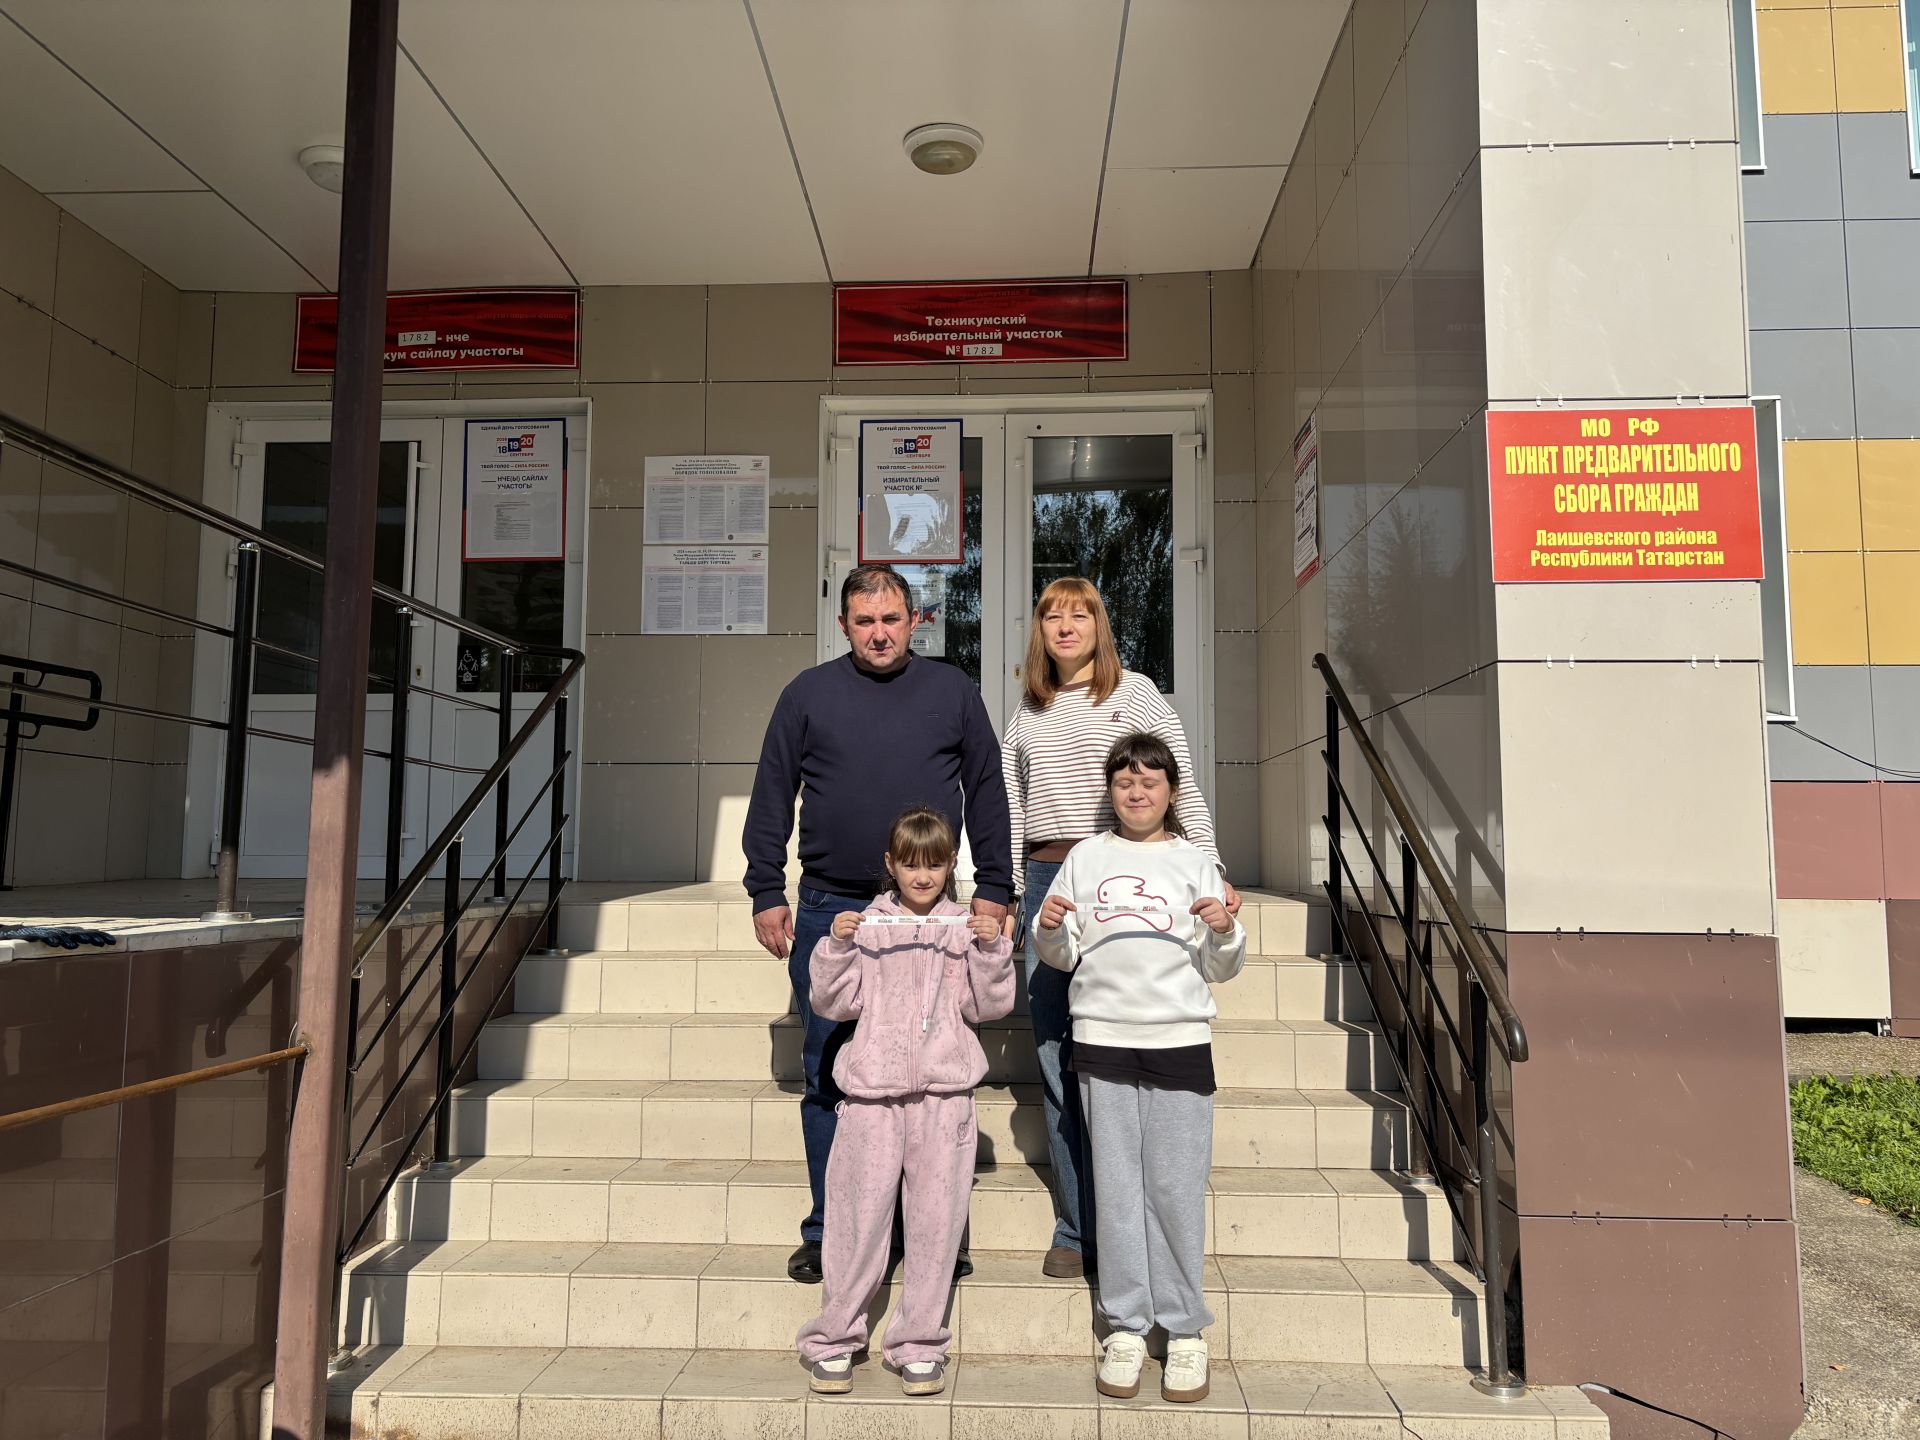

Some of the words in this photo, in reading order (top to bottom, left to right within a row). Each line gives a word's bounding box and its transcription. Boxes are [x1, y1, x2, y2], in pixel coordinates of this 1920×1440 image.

[925, 314, 1027, 328] Техникумский
[402, 333, 430, 342] 1782
[446, 333, 470, 342] нче
[893, 329, 1002, 343] избирательный
[1006, 330, 1063, 342] участок
[410, 348, 458, 360] сайлау
[460, 347, 524, 359] участогы
[945, 345, 961, 355] №
[966, 346, 995, 355] 1782
[1581, 417, 1611, 438] МО
[1628, 417, 1660, 437] РФ
[497, 446, 508, 454] 18
[509, 441, 519, 450] 19
[521, 437, 533, 446] 20
[894, 446, 904, 455] 18
[905, 442, 916, 450] 19
[917, 438, 930, 447] 20
[1505, 445, 1559, 475] ПУНКТ
[1562, 442, 1742, 478] ПРЕДВАРИТЕЛЬНОГО
[883, 475, 940, 483] ИЗБИРАТЕЛЬНЫЙ
[1553, 483, 1612, 514] СБОРА
[1614, 482, 1700, 517] ГРАЖДАН
[1535, 528, 1652, 547] Лаишевского
[1654, 527, 1718, 547] района
[1530, 549, 1633, 568] Республики
[1636, 548, 1725, 567] Татарстан
